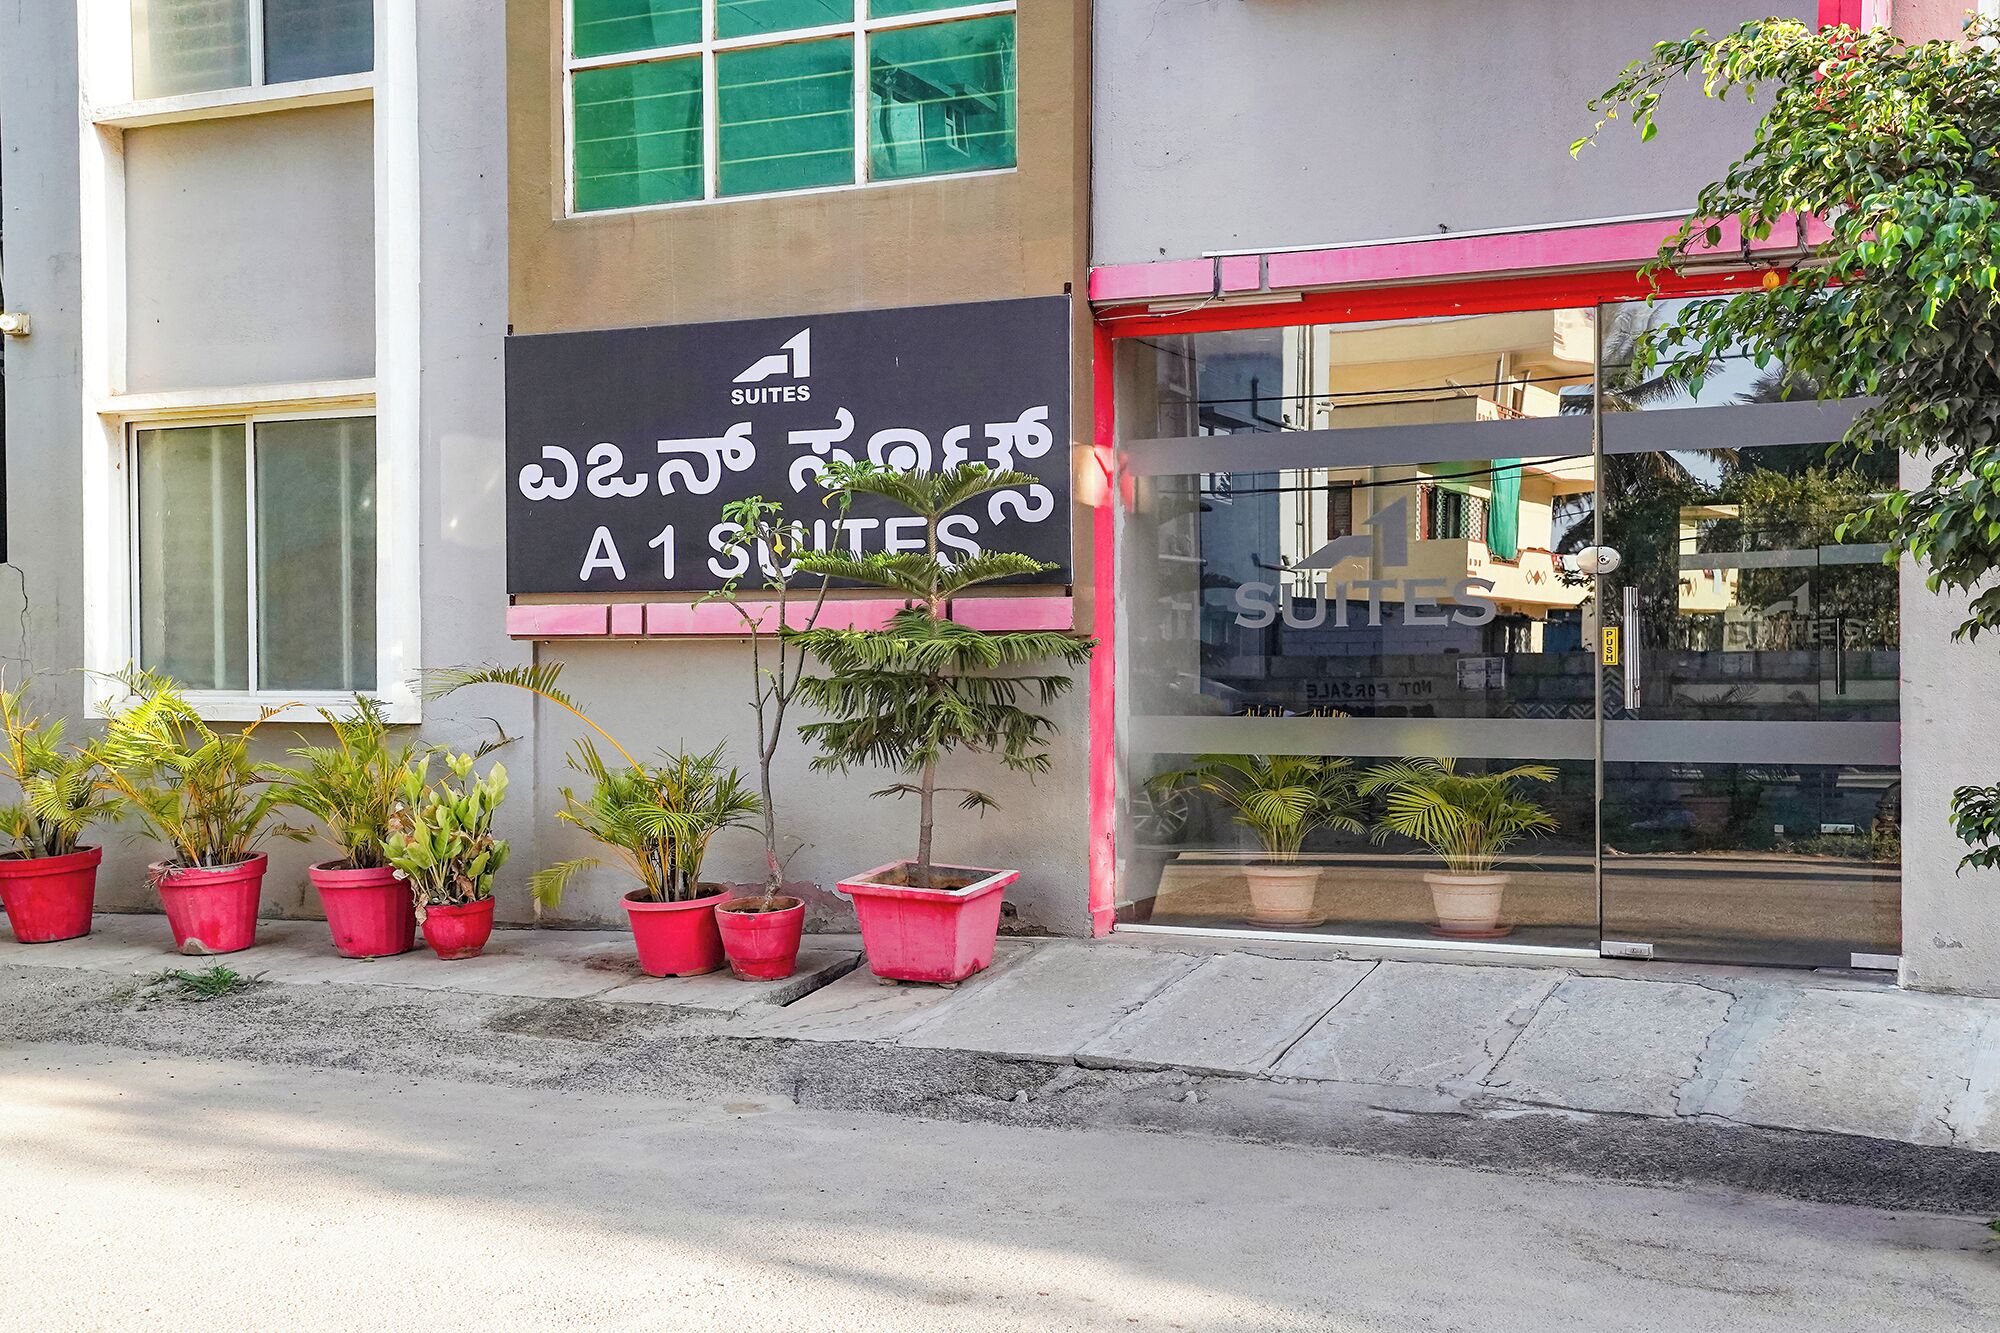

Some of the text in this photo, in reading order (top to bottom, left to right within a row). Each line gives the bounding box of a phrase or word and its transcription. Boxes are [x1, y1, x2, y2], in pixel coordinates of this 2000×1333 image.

[730, 385, 811, 405] SUITES
[518, 421, 757, 501] ಎಒನ್
[579, 525, 627, 581] A
[648, 524, 675, 580] 1
[1234, 576, 1497, 629] SUITES
[1605, 630, 1614, 662] PUSH
